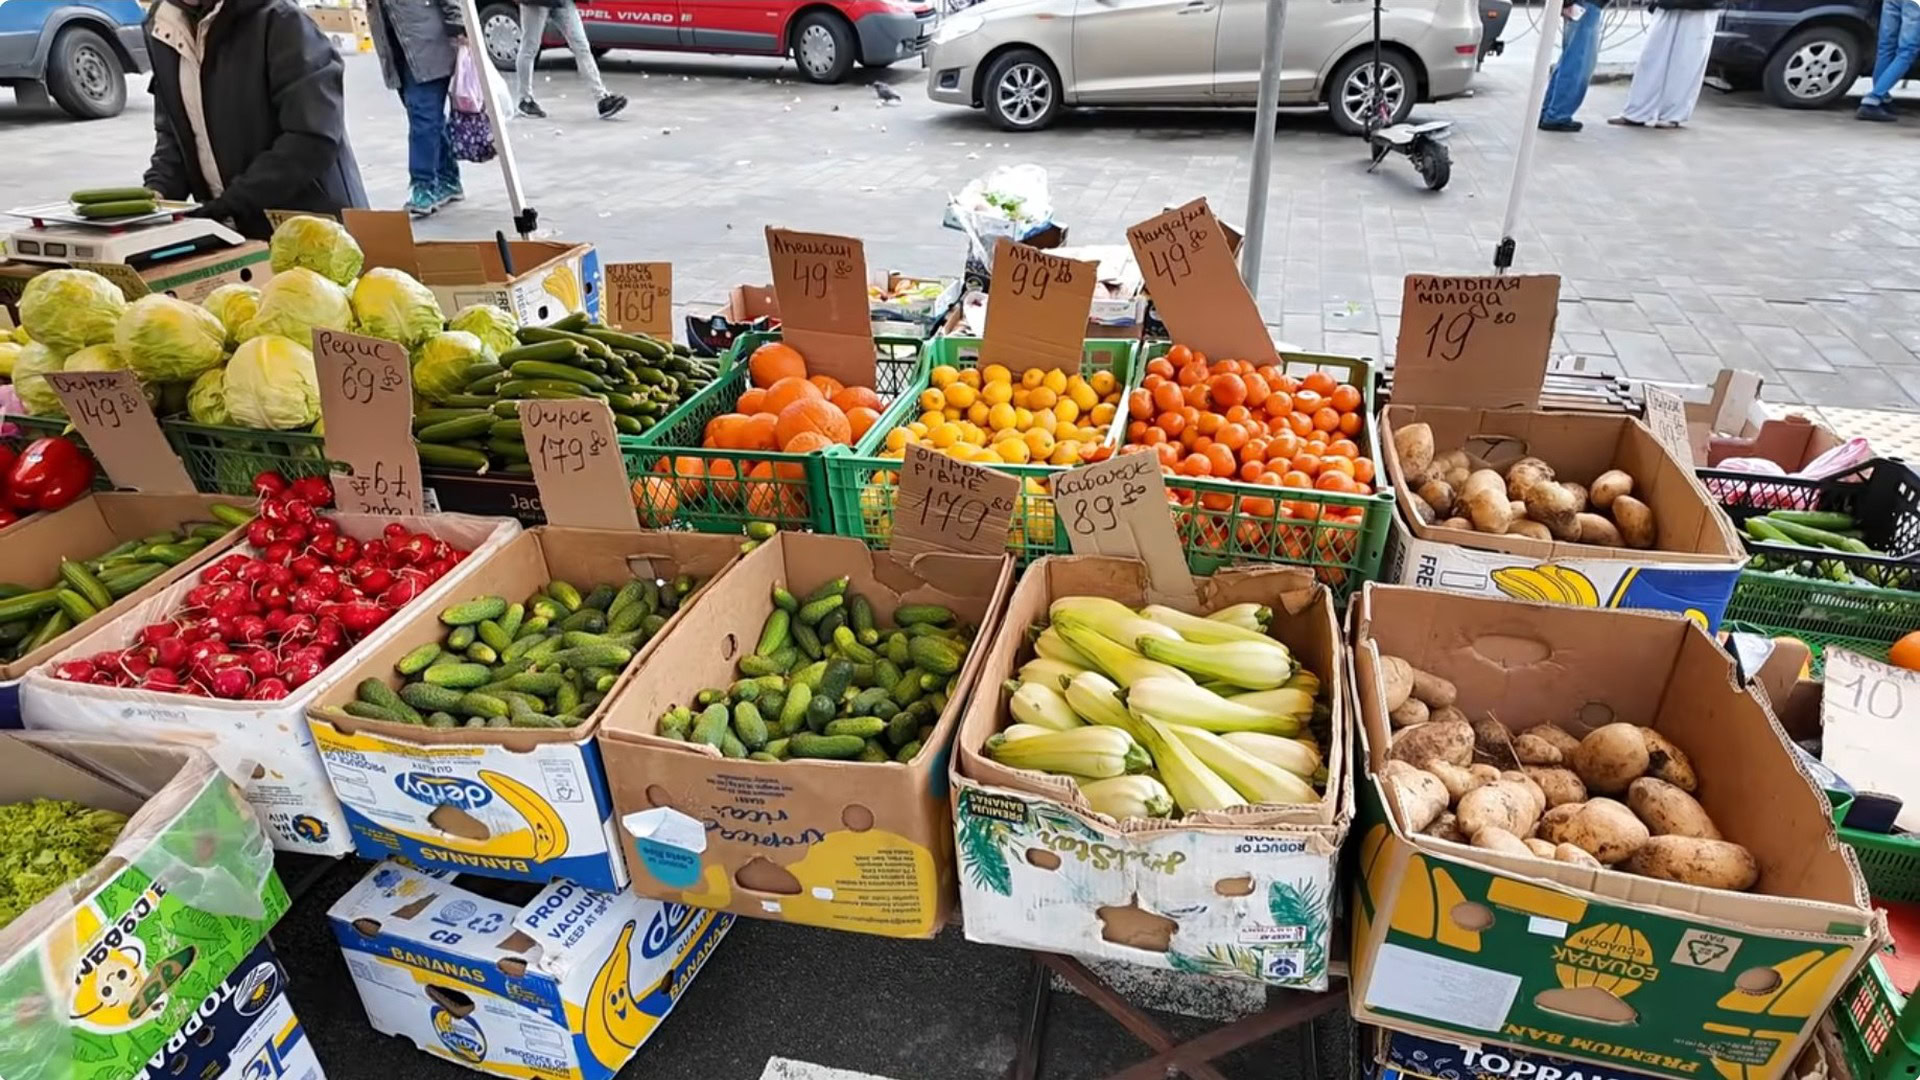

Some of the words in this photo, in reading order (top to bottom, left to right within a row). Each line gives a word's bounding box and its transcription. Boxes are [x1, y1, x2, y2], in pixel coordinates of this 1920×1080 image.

[578, 9, 612, 19] OPEL
[617, 11, 674, 22] VIVARO
[793, 259, 827, 298] 49
[1011, 262, 1050, 300] 99
[1149, 243, 1191, 287] 49
[1414, 278, 1520, 291] КАРТОПЛЯ
[615, 290, 655, 324] 169
[320, 331, 392, 366] Редис
[1425, 312, 1475, 361] 19
[342, 365, 375, 404] 69
[76, 398, 121, 428] 149
[539, 434, 586, 475] 179
[914, 463, 980, 492] РІВНЕ
[912, 486, 989, 541] 179
[1074, 495, 1117, 535] 89
[403, 772, 487, 812] derby
[971, 804, 1024, 823] PREMIUM
[420, 847, 530, 873] BANANAS
[1254, 843, 1306, 853] RODUCT
[429, 930, 462, 945] CB
[562, 924, 586, 949] KEEP
[588, 916, 598, 928] AT
[676, 910, 709, 955] QUALIT
[1579, 936, 1645, 958] ECUADOR
[1700, 933, 1725, 943] PAP
[389, 946, 486, 983] BANANAS
[669, 916, 731, 1000] BANANAS
[1551, 945, 1660, 982] EQUAPAK
[1458, 1045, 1618, 1080] TOPRA
[1568, 1036, 1701, 1073] PREMIUM
